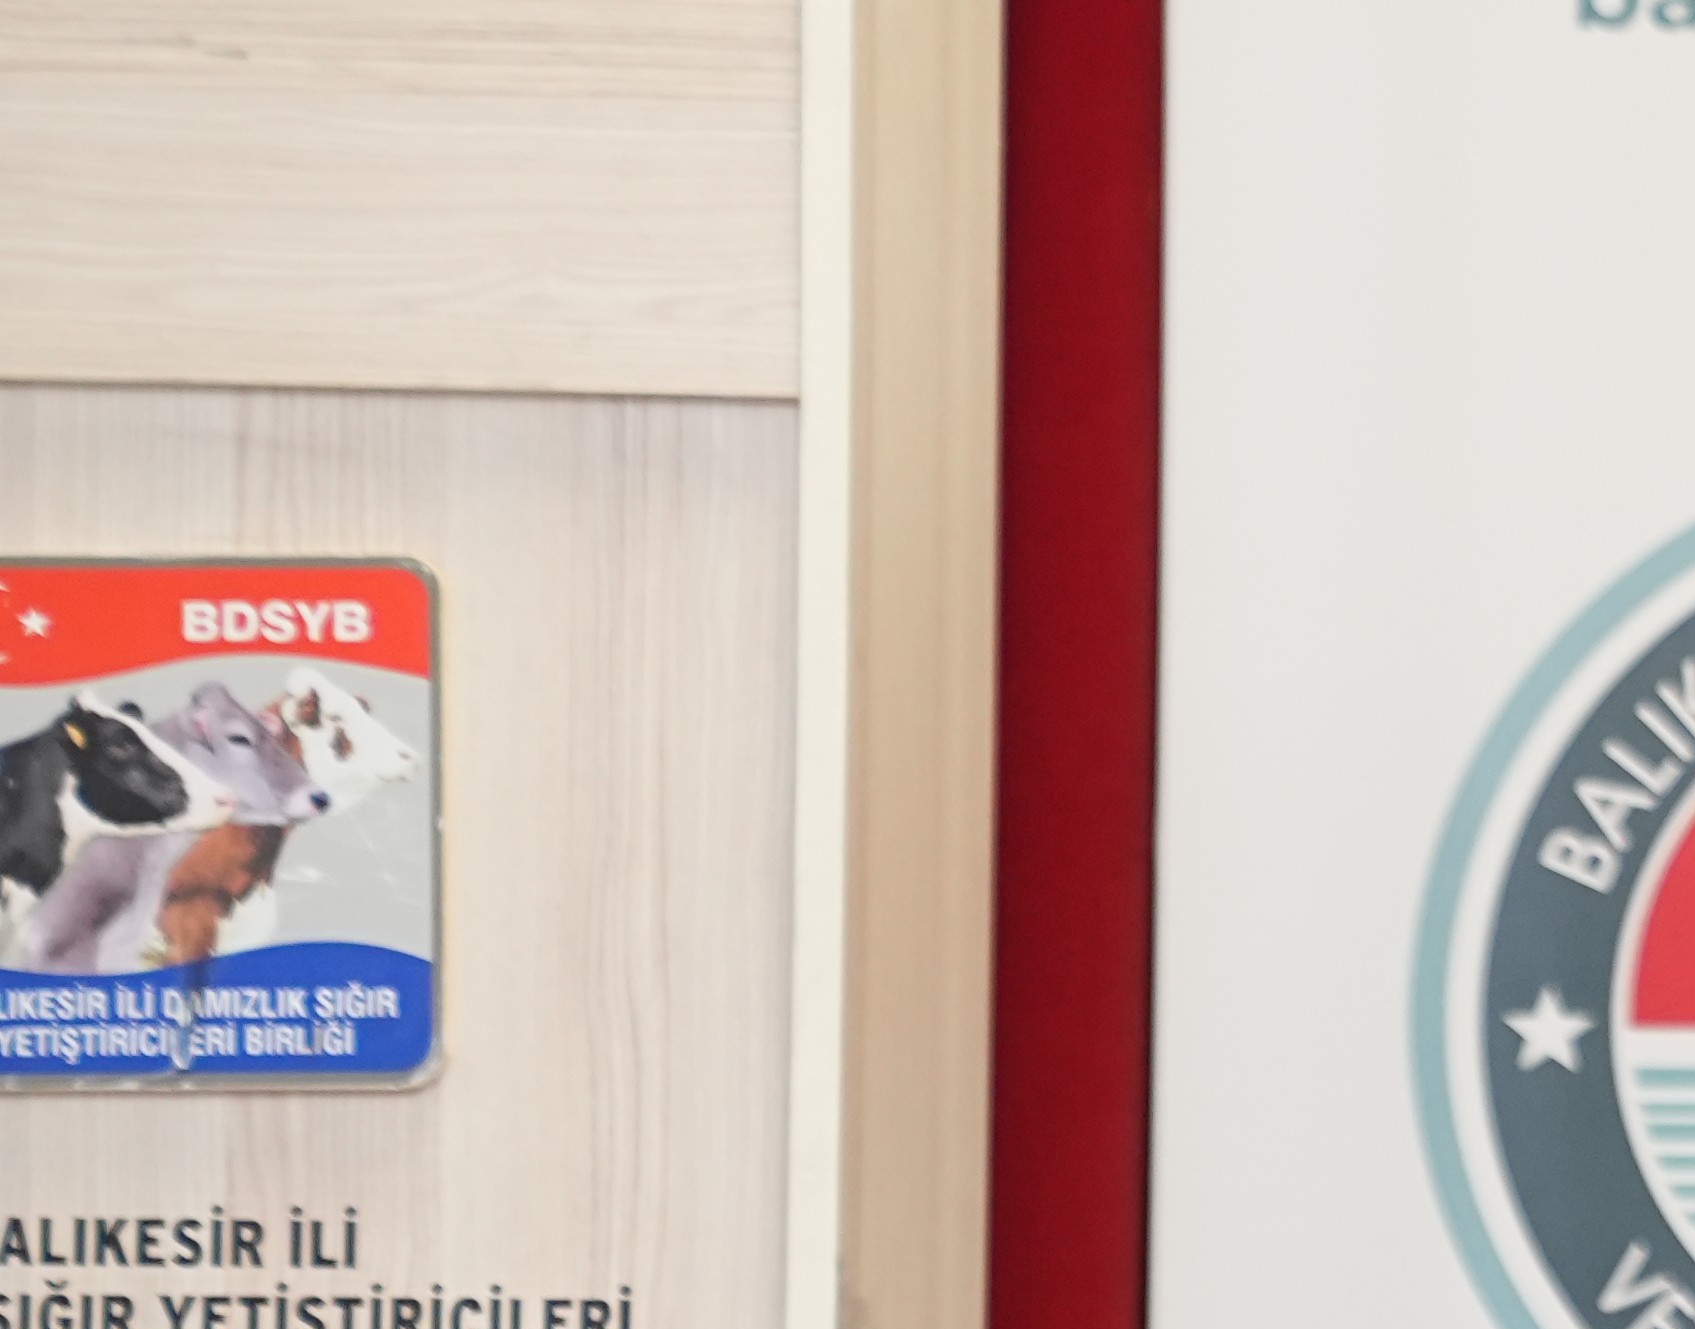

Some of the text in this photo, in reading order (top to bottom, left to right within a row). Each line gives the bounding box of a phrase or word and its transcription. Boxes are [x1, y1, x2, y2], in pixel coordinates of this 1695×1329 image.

[182, 600, 372, 643] BDSYB
[116, 981, 155, 1018] İLİ
[313, 981, 399, 1019] SIĞIR
[244, 1018, 357, 1057] BİRLİĞİ
[289, 1206, 358, 1269] İLİ
